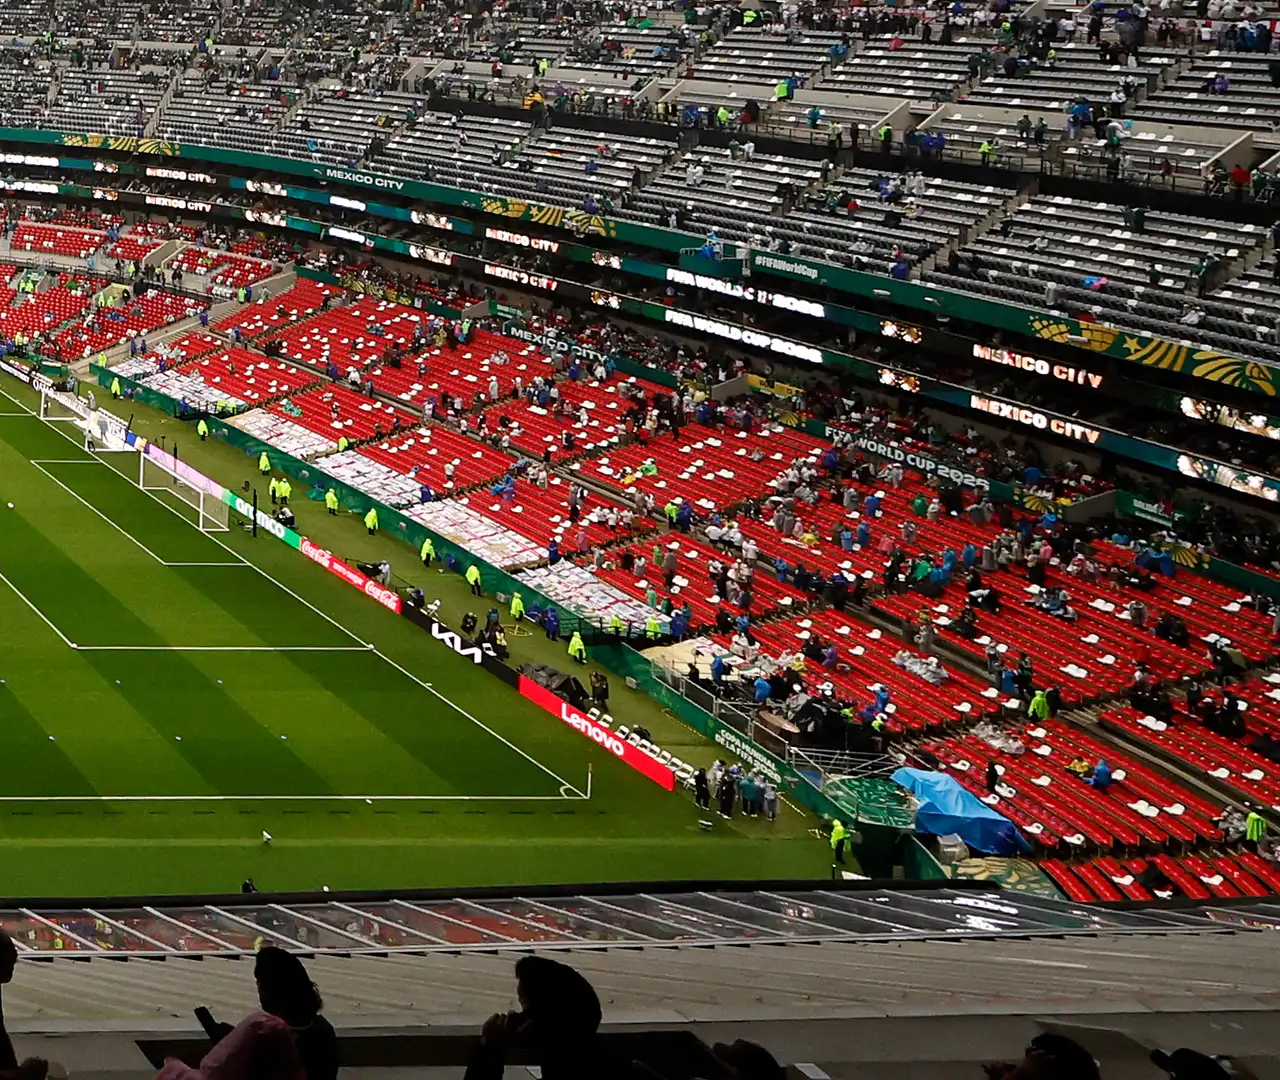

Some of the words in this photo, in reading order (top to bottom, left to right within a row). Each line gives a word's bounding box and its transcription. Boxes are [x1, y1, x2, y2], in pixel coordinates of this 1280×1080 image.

[326, 169, 373, 186] MEXICO
[375, 178, 404, 191] CITY
[531, 238, 560, 254] CITY
[755, 254, 819, 280] #FIFAWorldCup
[510, 327, 568, 352] MEXICO
[571, 345, 608, 364] CITY
[970, 393, 1048, 429] MEXICO
[1050, 418, 1101, 444] CITY
[906, 454, 936, 471] CUP
[561, 703, 625, 757] Lenovo
[715, 733, 726, 746] DE
[726, 740, 736, 753] LA
[736, 747, 753, 764] FIFA
[721, 729, 741, 747] COPA
[742, 742, 777, 771] MUNDIAL
